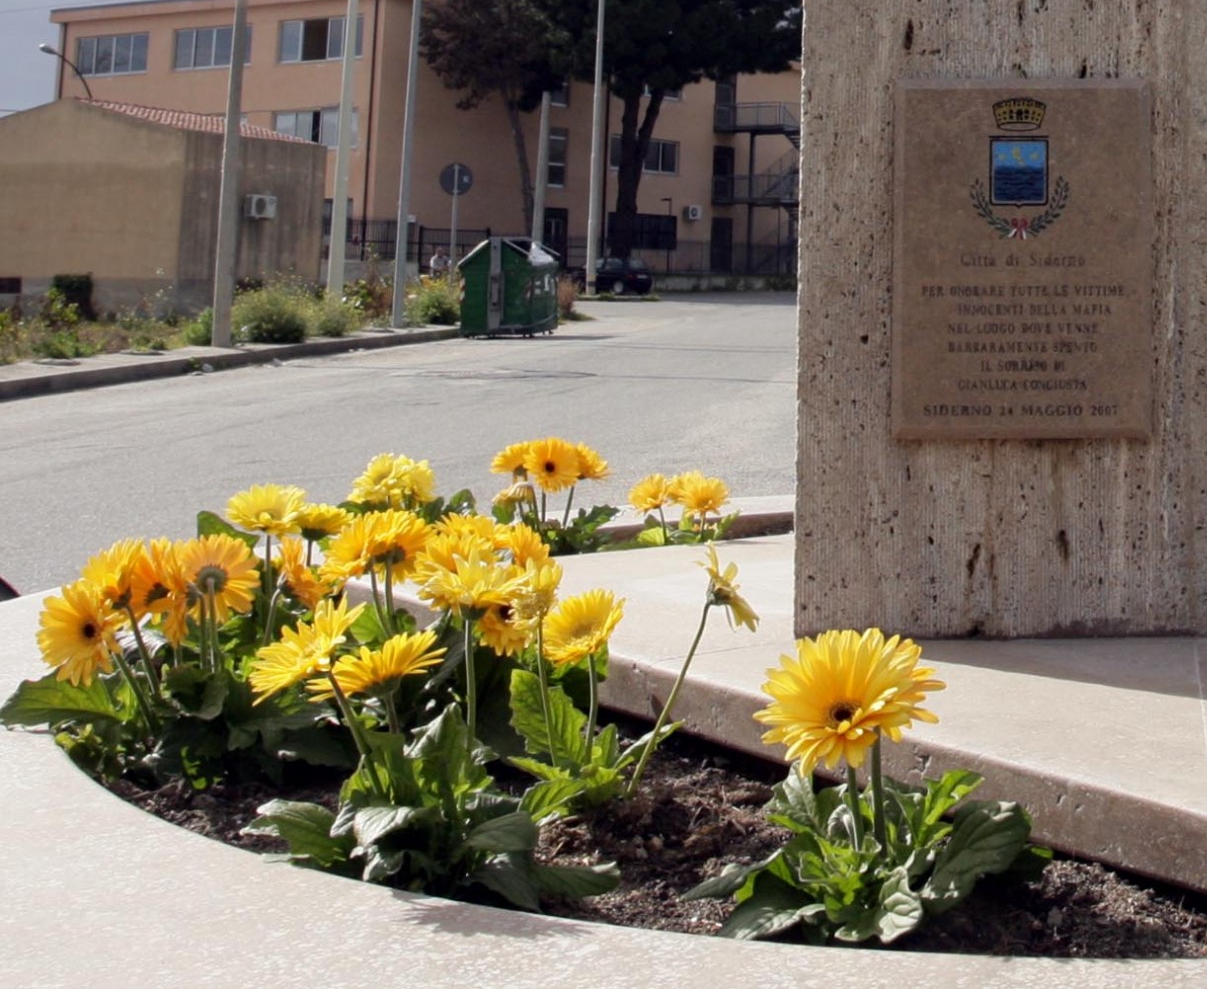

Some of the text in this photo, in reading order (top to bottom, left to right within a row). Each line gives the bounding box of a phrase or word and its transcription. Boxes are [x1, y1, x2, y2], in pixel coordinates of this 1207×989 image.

[1005, 252, 1019, 267] di
[1029, 252, 1086, 267] Siderno
[921, 284, 1126, 298] PER ONORARE TUTTE LE VITTIME
[958, 304, 1112, 316] INNOCENTI DELLA MAFIA
[948, 322, 1099, 335] NEL LUOGO DOVE VENNE
[948, 341, 1098, 354] BARBARAMENTE SPENTO
[980, 360, 1065, 372] IL SORRISO DI
[957, 379, 1088, 391] GIANLUCA CONGIUSTA
[923, 404, 993, 417] SIDERNO
[1020, 404, 1083, 417] MAGGIO
